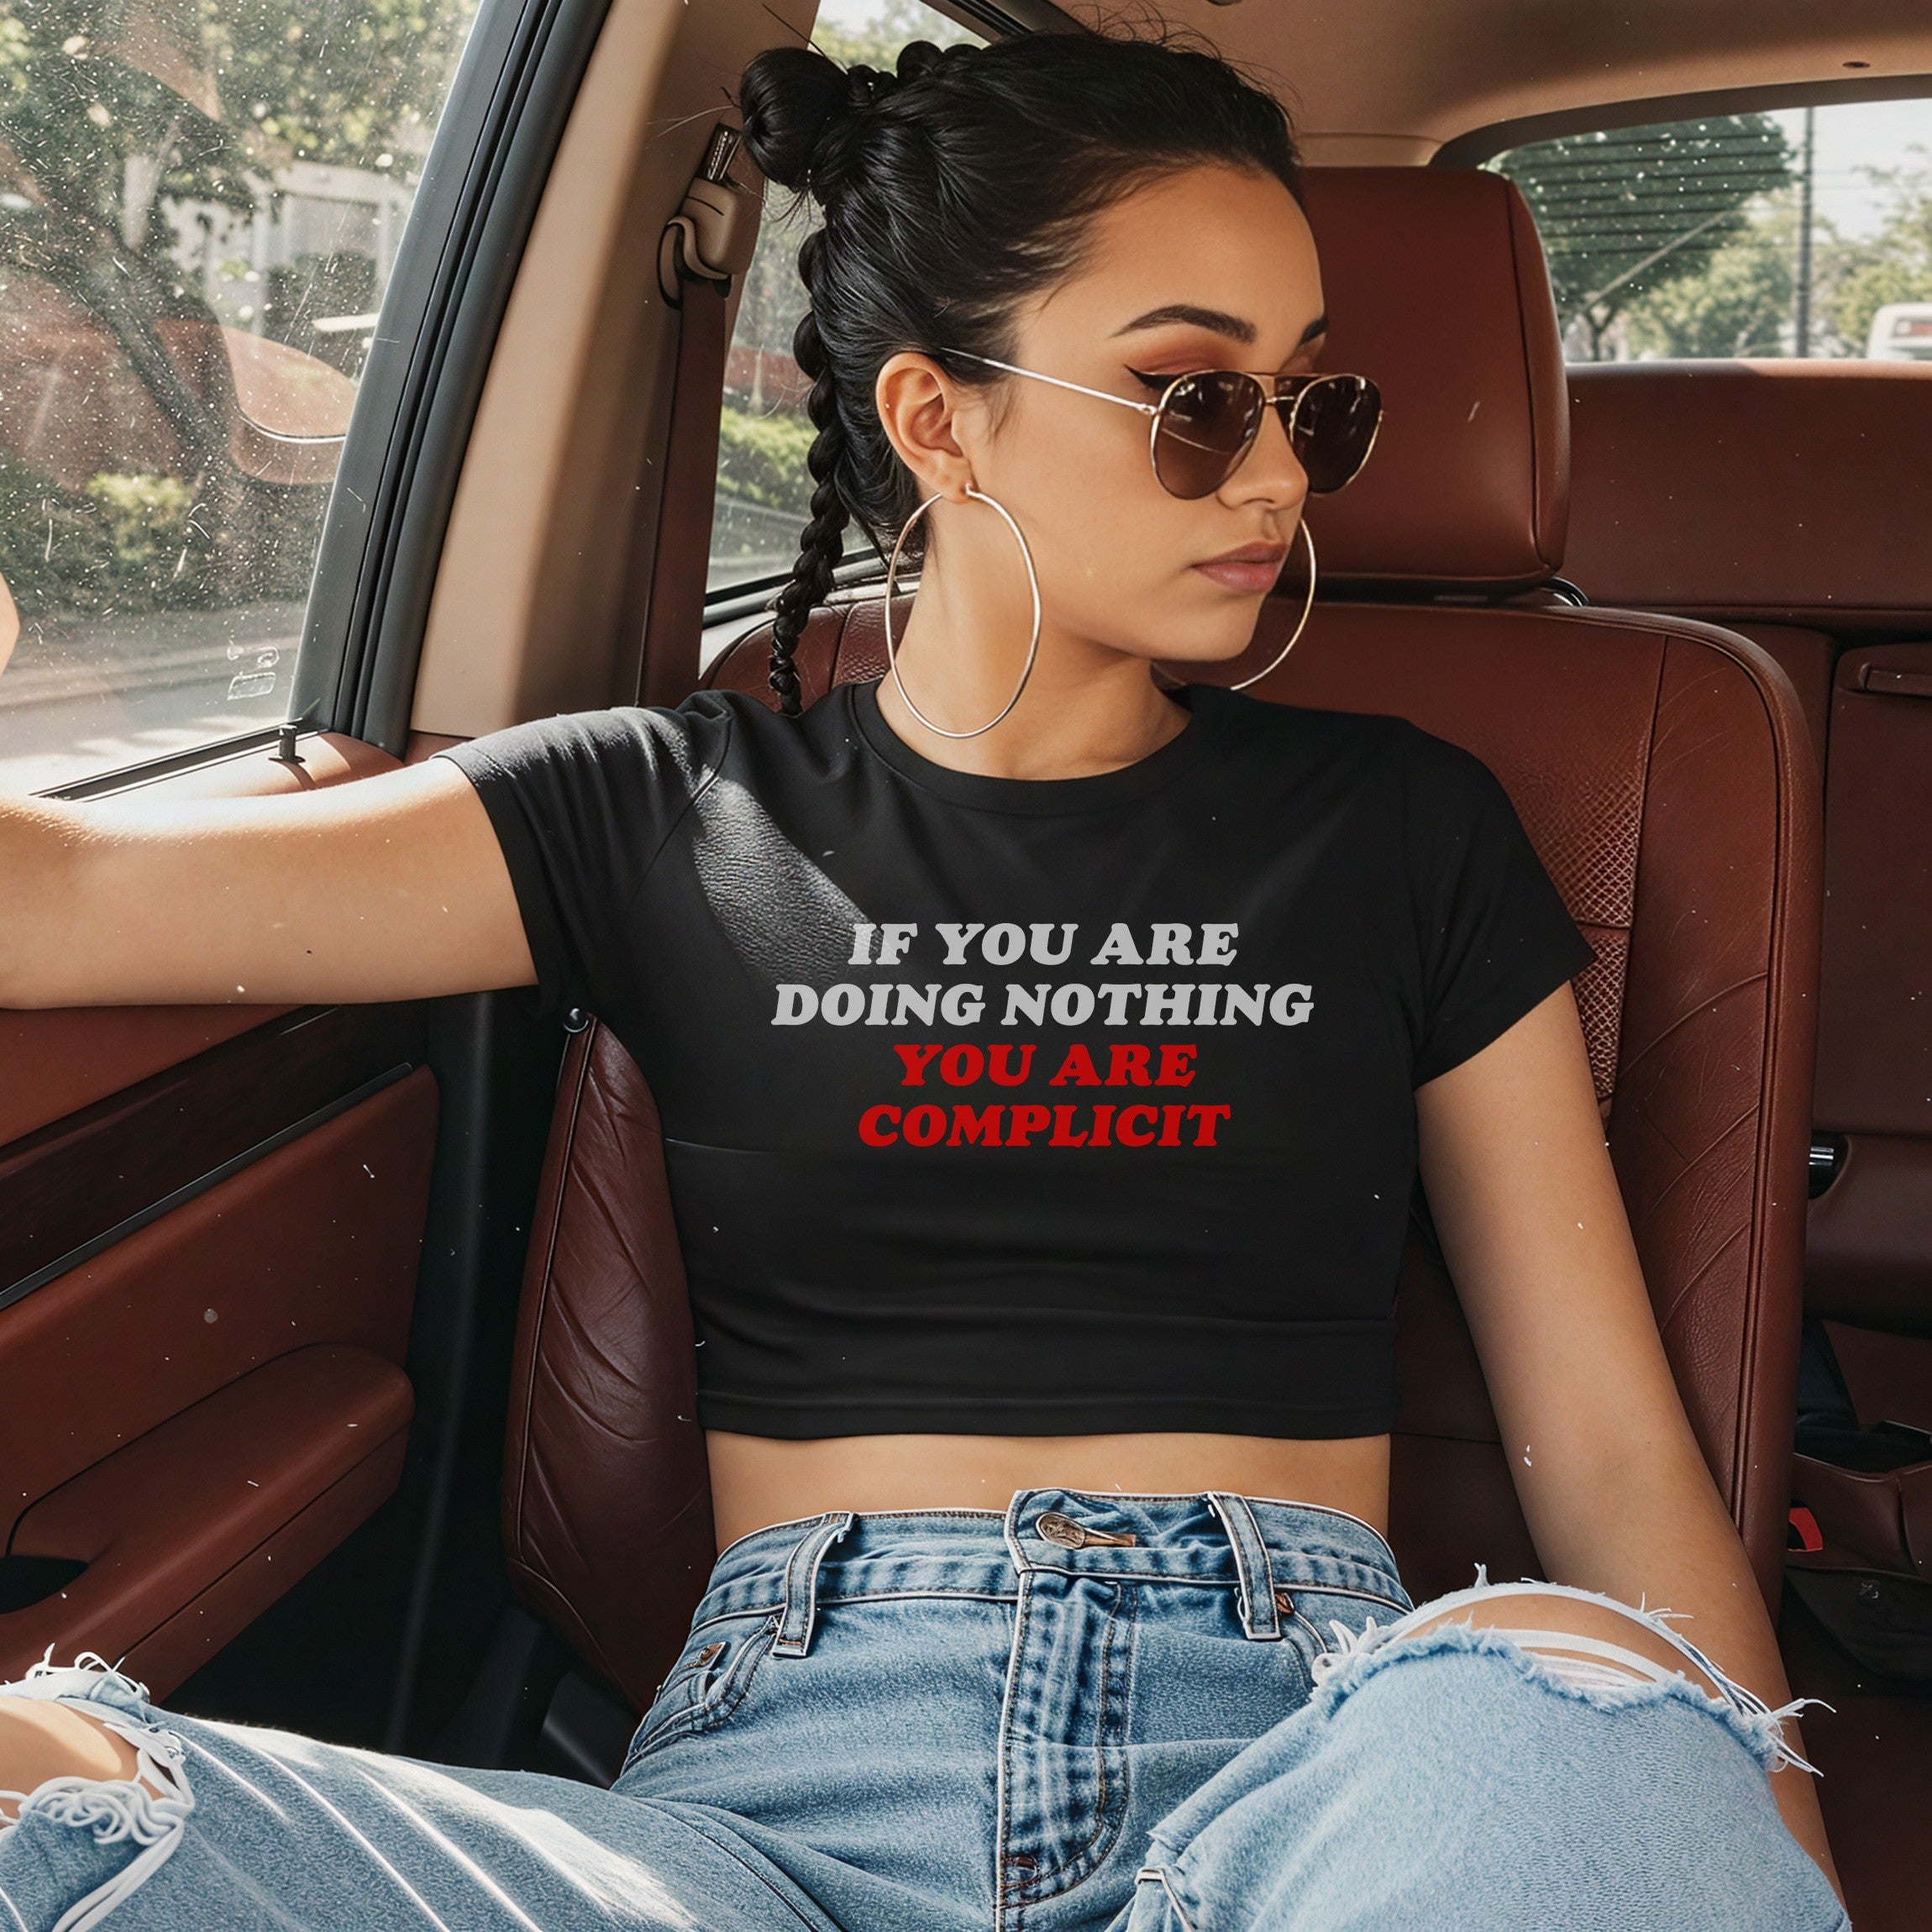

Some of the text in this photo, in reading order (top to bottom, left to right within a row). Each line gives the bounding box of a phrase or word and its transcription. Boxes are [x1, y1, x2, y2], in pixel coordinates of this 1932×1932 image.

[848, 922, 1239, 966] IF YOU ARE
[770, 983, 1315, 1026] DOING NOTHING
[894, 1043, 1198, 1087] YOU ARE
[858, 1104, 1231, 1148] COMPLICIT
